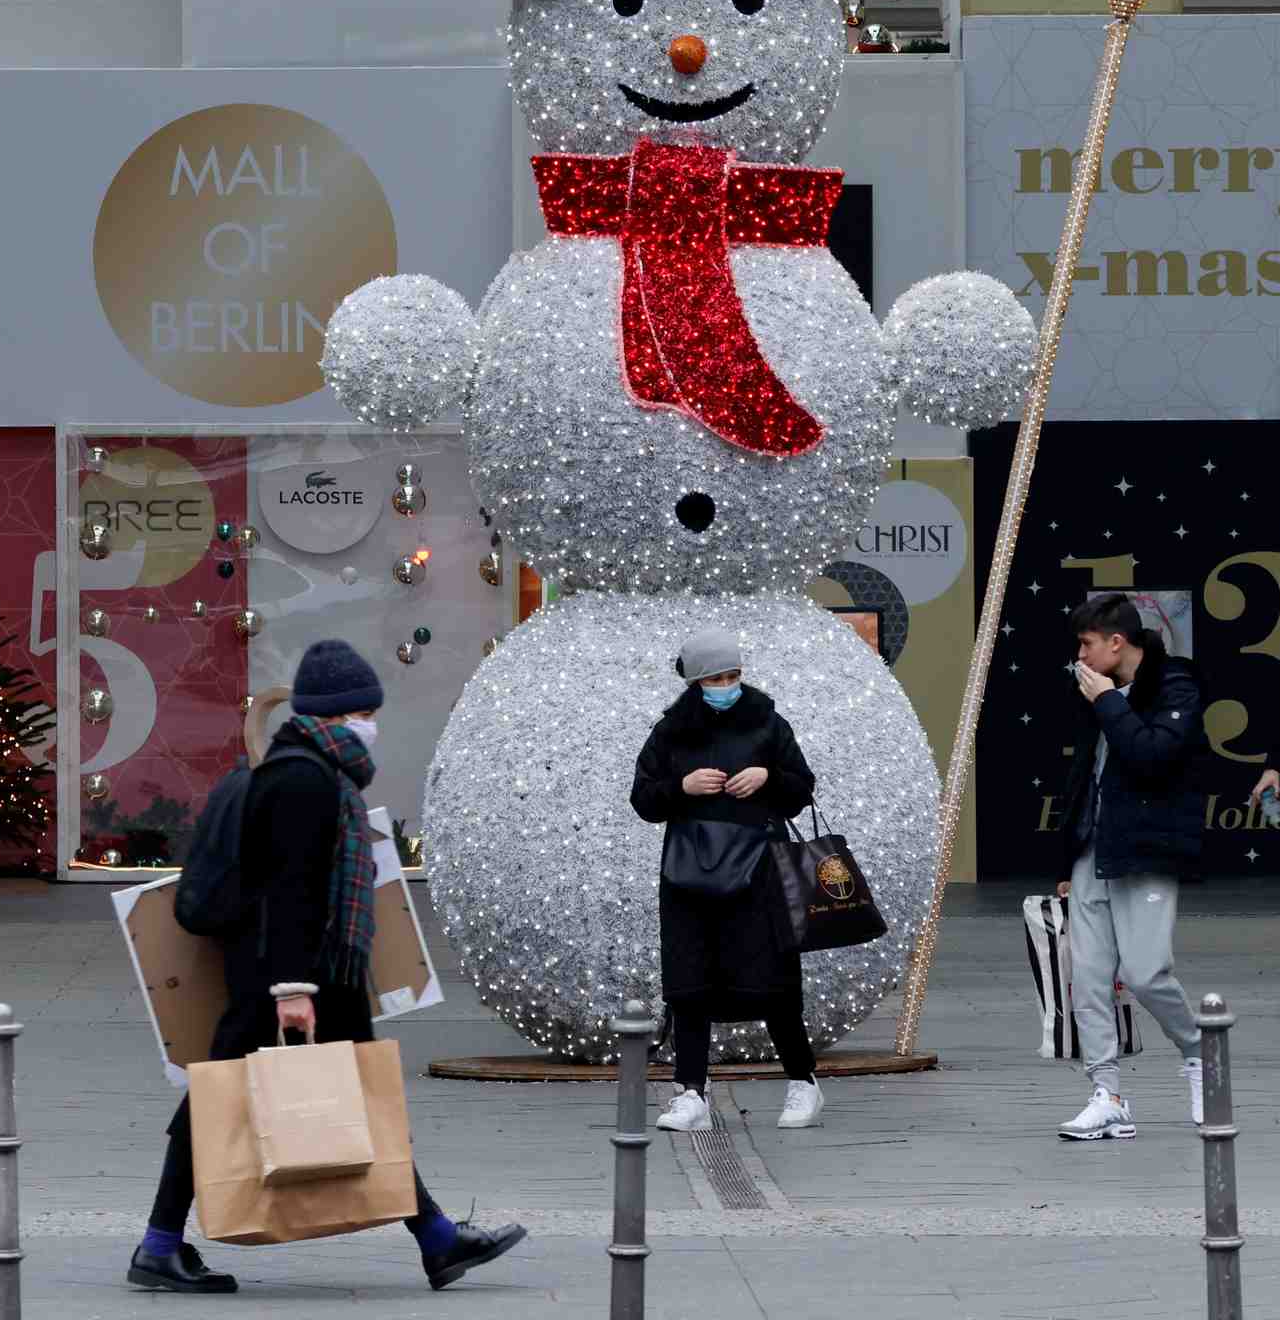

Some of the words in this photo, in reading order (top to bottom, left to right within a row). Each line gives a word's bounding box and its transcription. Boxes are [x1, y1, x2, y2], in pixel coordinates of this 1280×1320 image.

[169, 143, 321, 197] MALL
[203, 221, 289, 273] OF
[278, 491, 364, 505] LACOSTE
[84, 500, 203, 532] BREE
[855, 524, 953, 553] CHRIST
